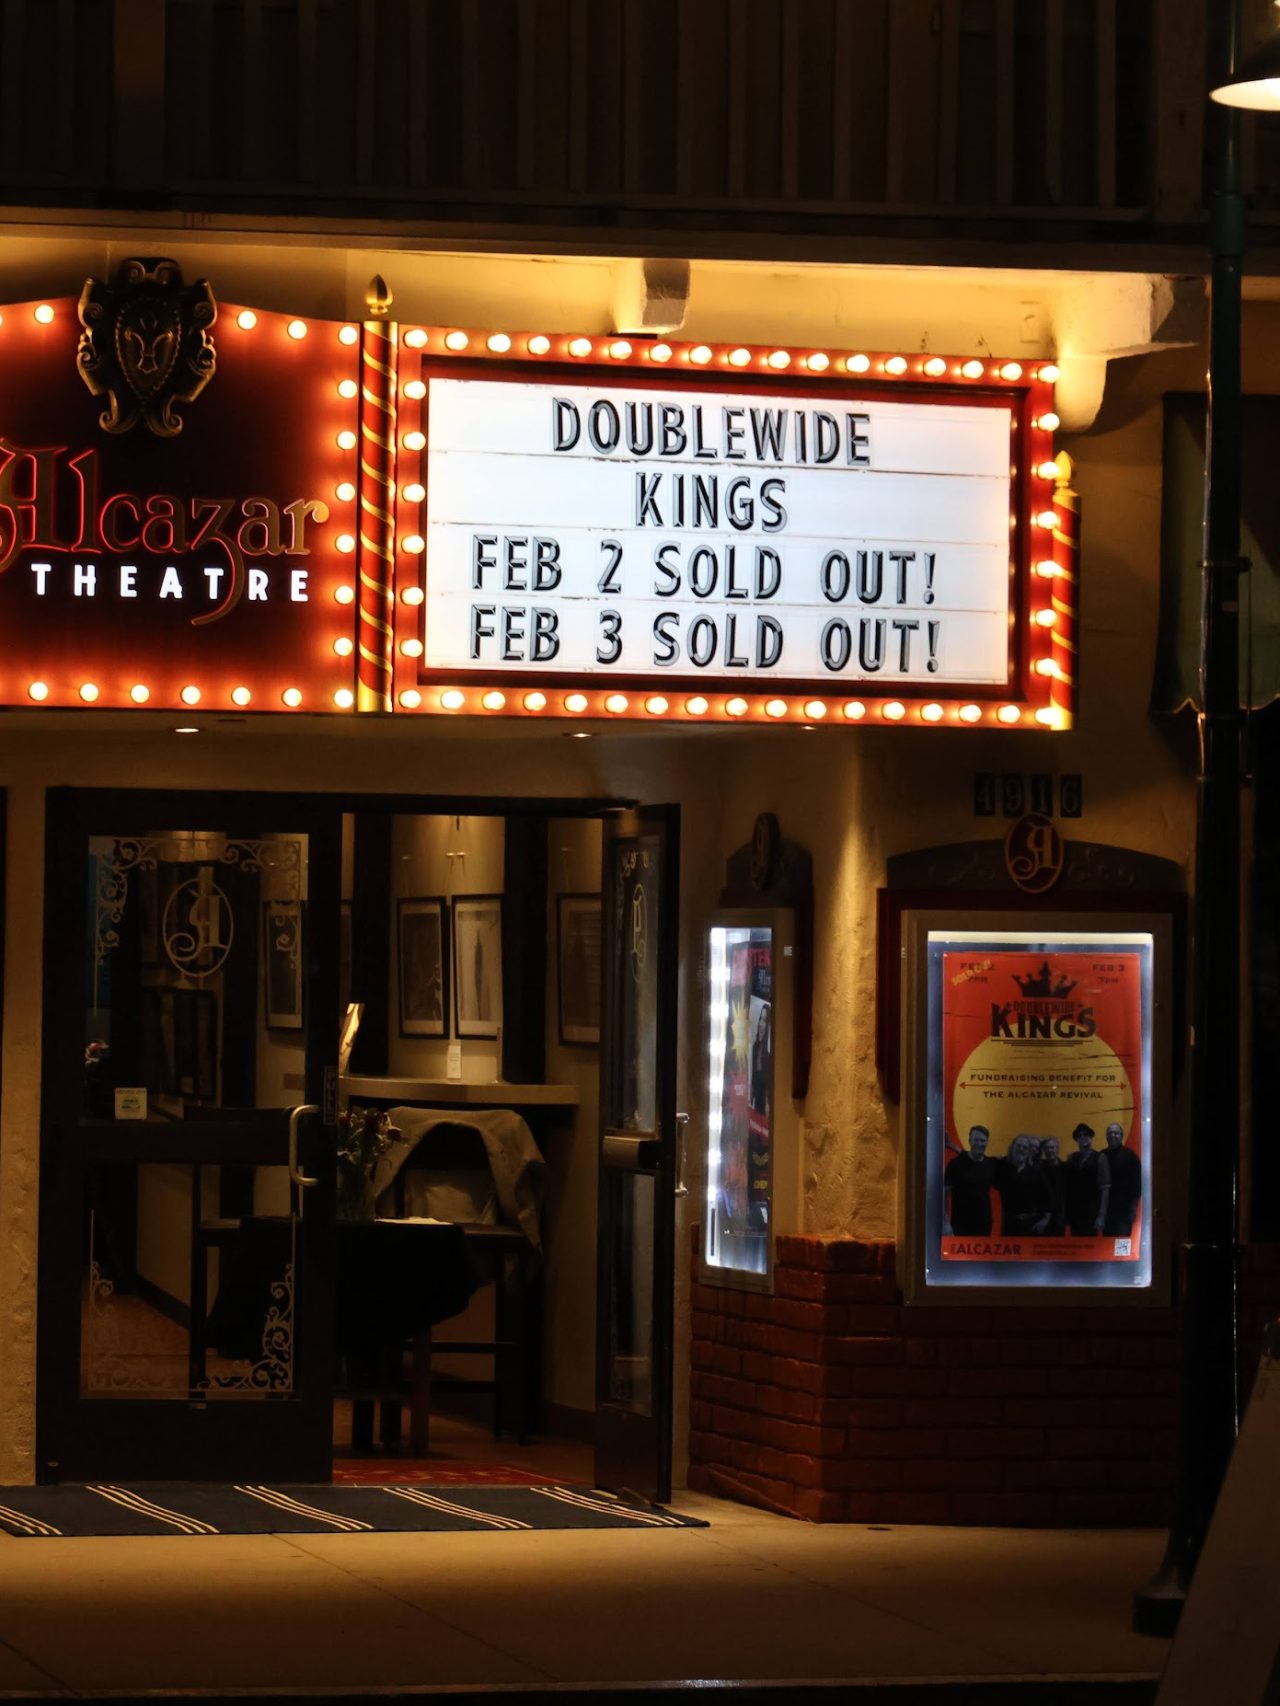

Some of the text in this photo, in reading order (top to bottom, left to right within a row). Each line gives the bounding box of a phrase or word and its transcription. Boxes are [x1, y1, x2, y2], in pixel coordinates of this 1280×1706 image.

[551, 396, 870, 466] DOUBLEWIDE
[635, 472, 788, 532] KINGS
[31, 563, 308, 602] THEATRE
[471, 534, 937, 605] FEB 2 SOLD OUT!
[469, 603, 941, 673] FEB 3 SOLD OUT!
[976, 774, 1081, 816] 4916
[992, 1002, 1096, 1038] KINGS
[956, 1243, 1022, 1255] ALCAZAR
